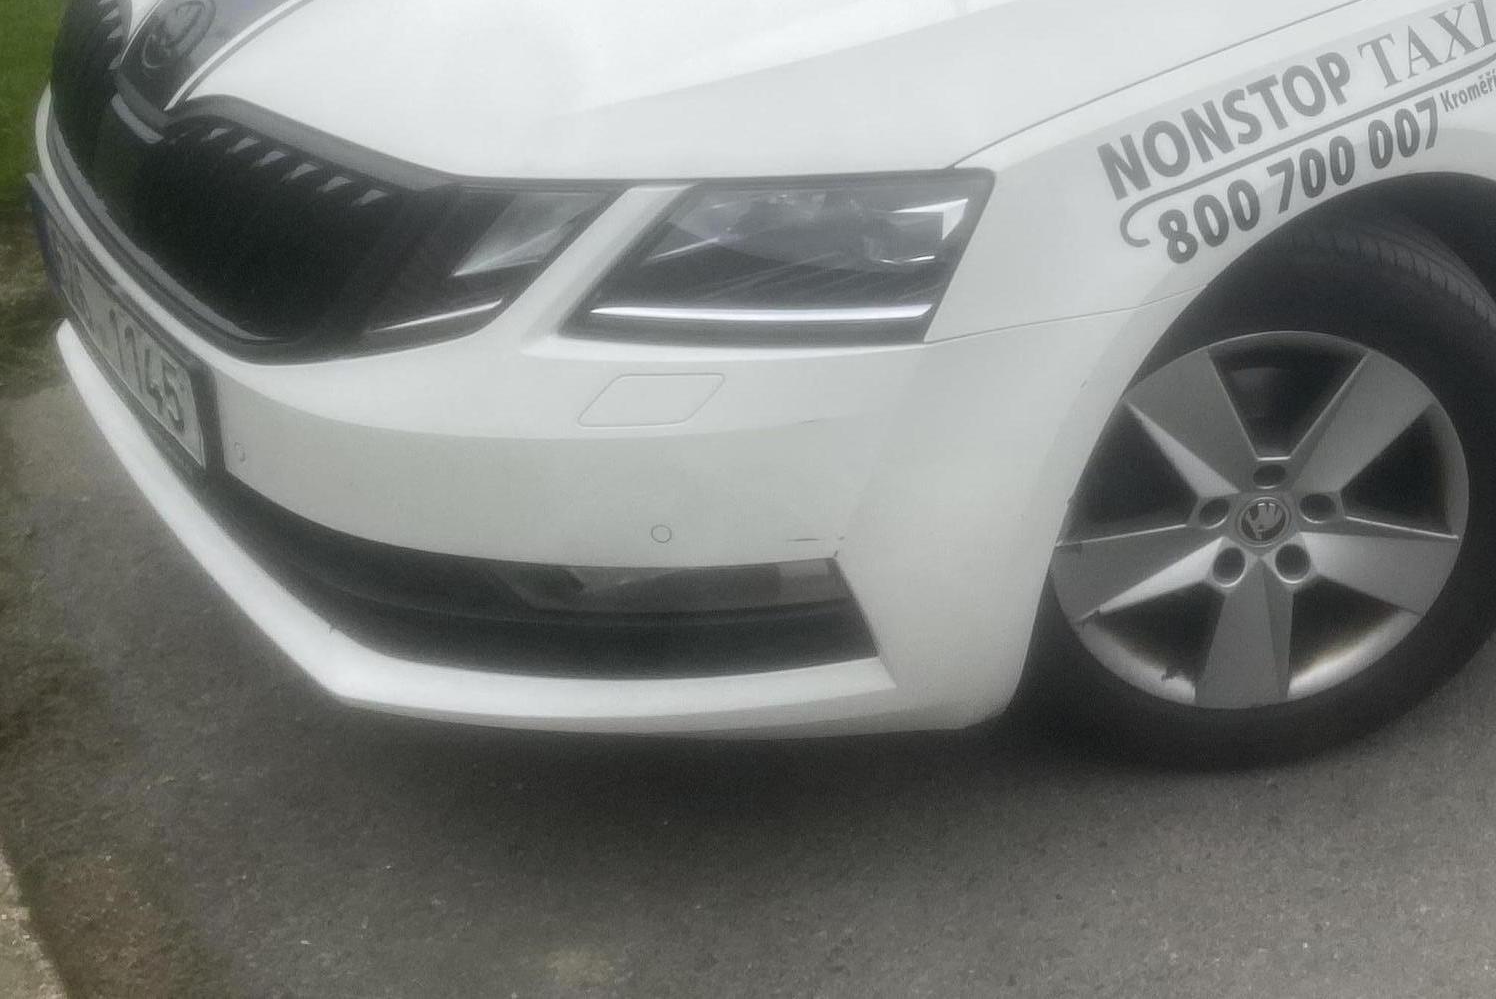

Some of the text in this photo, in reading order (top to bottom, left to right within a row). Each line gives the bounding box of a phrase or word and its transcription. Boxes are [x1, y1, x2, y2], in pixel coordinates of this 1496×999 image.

[1097, 51, 1351, 200] NONSTOP
[1157, 98, 1439, 264] 800 700 007
